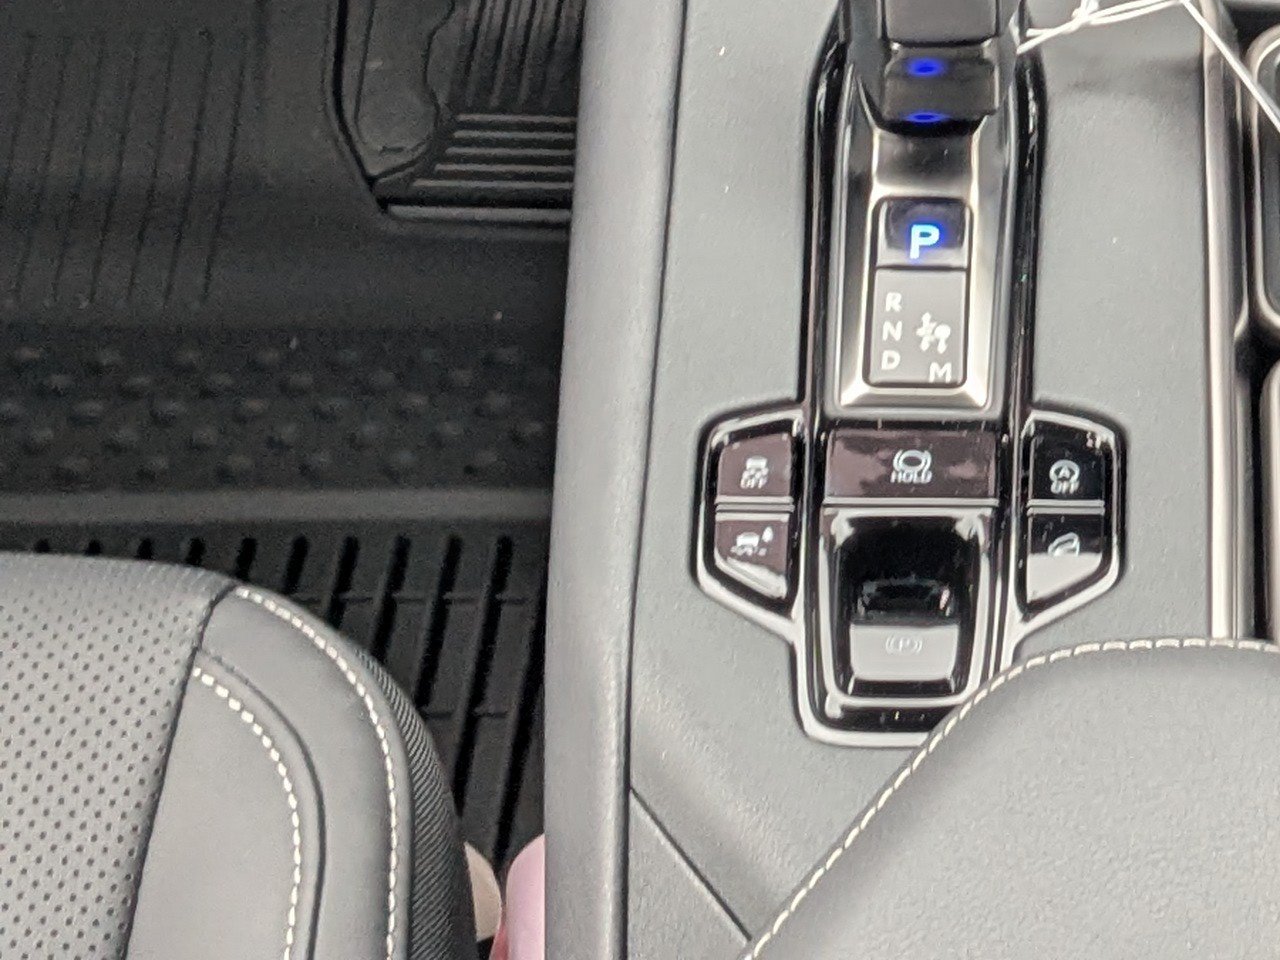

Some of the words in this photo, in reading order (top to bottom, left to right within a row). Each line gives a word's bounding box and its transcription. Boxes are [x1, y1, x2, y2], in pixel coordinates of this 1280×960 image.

[909, 224, 940, 259] P
[885, 292, 902, 312] R
[882, 321, 903, 341] N
[881, 350, 901, 370] D
[928, 362, 952, 384] M
[890, 470, 933, 484] HOLD
